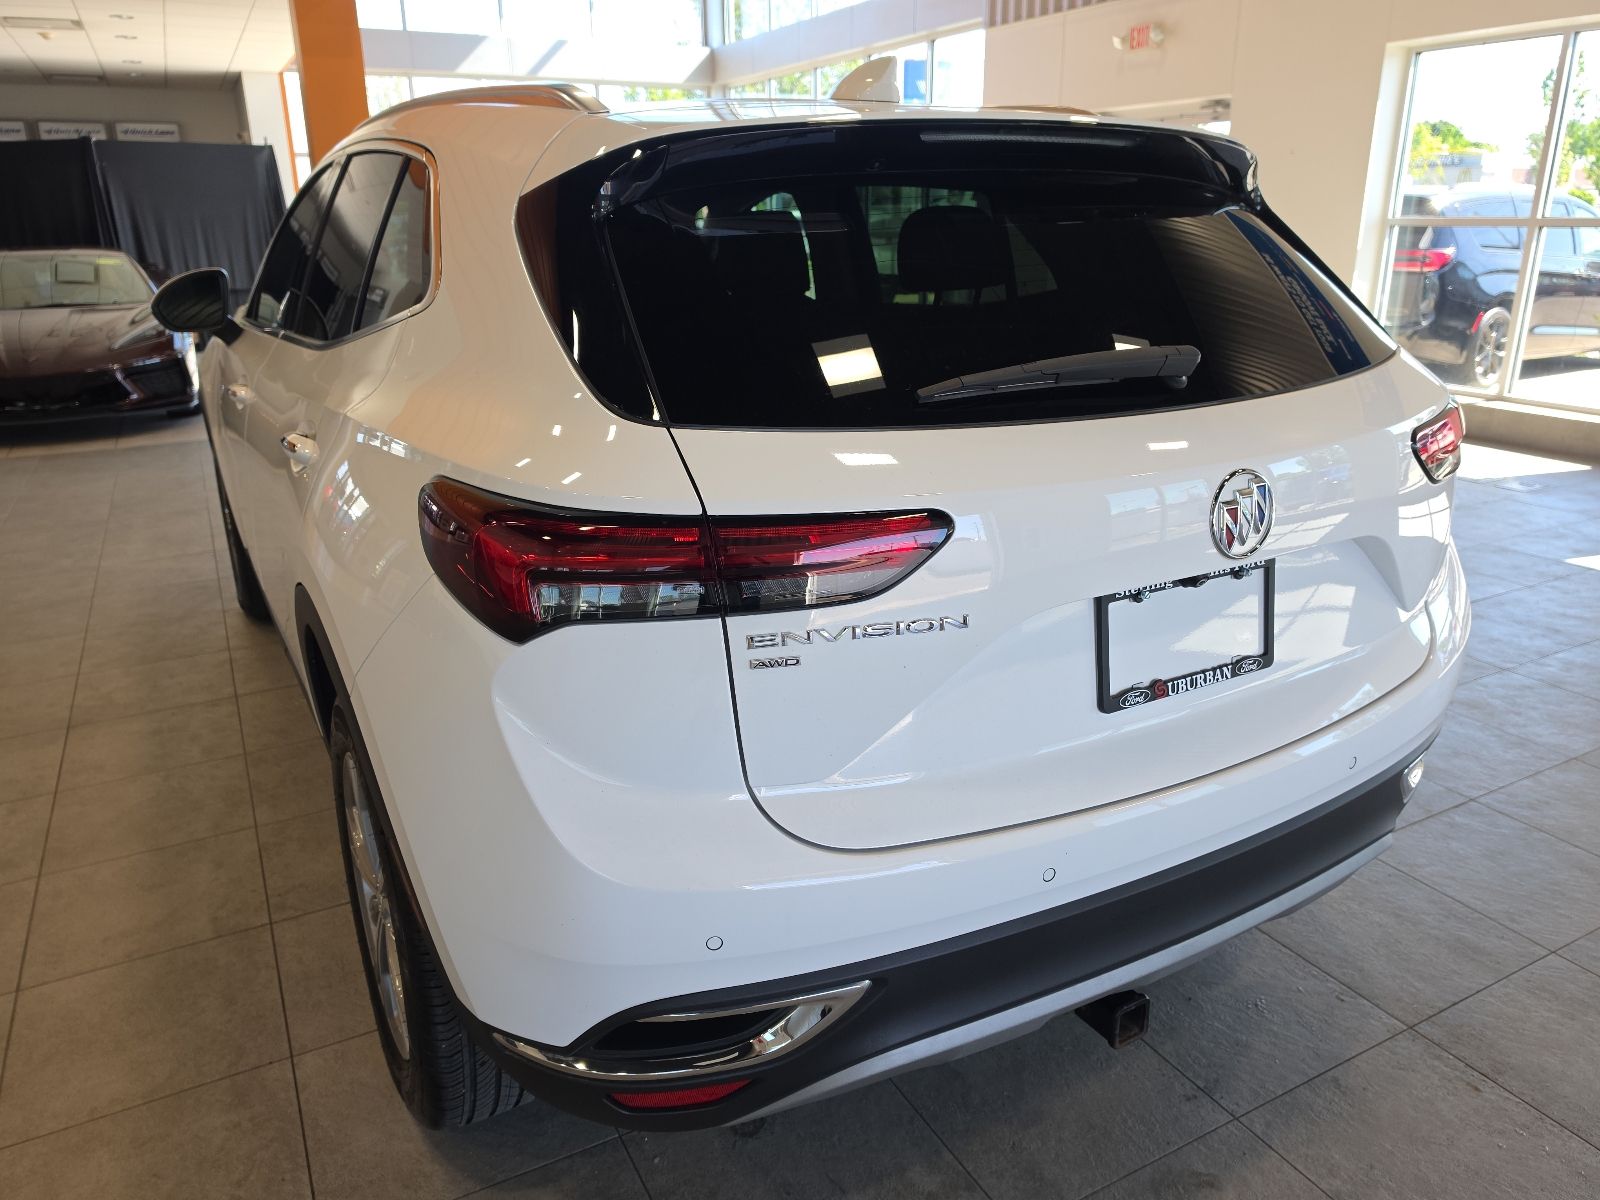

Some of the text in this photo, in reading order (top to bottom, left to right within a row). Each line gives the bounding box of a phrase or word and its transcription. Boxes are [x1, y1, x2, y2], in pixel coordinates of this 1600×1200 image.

[1129, 23, 1151, 49] EXIT
[746, 613, 970, 650] ENVISION
[750, 655, 801, 670] AWD
[1124, 658, 1261, 706] Ford SUBURBAN Ford
